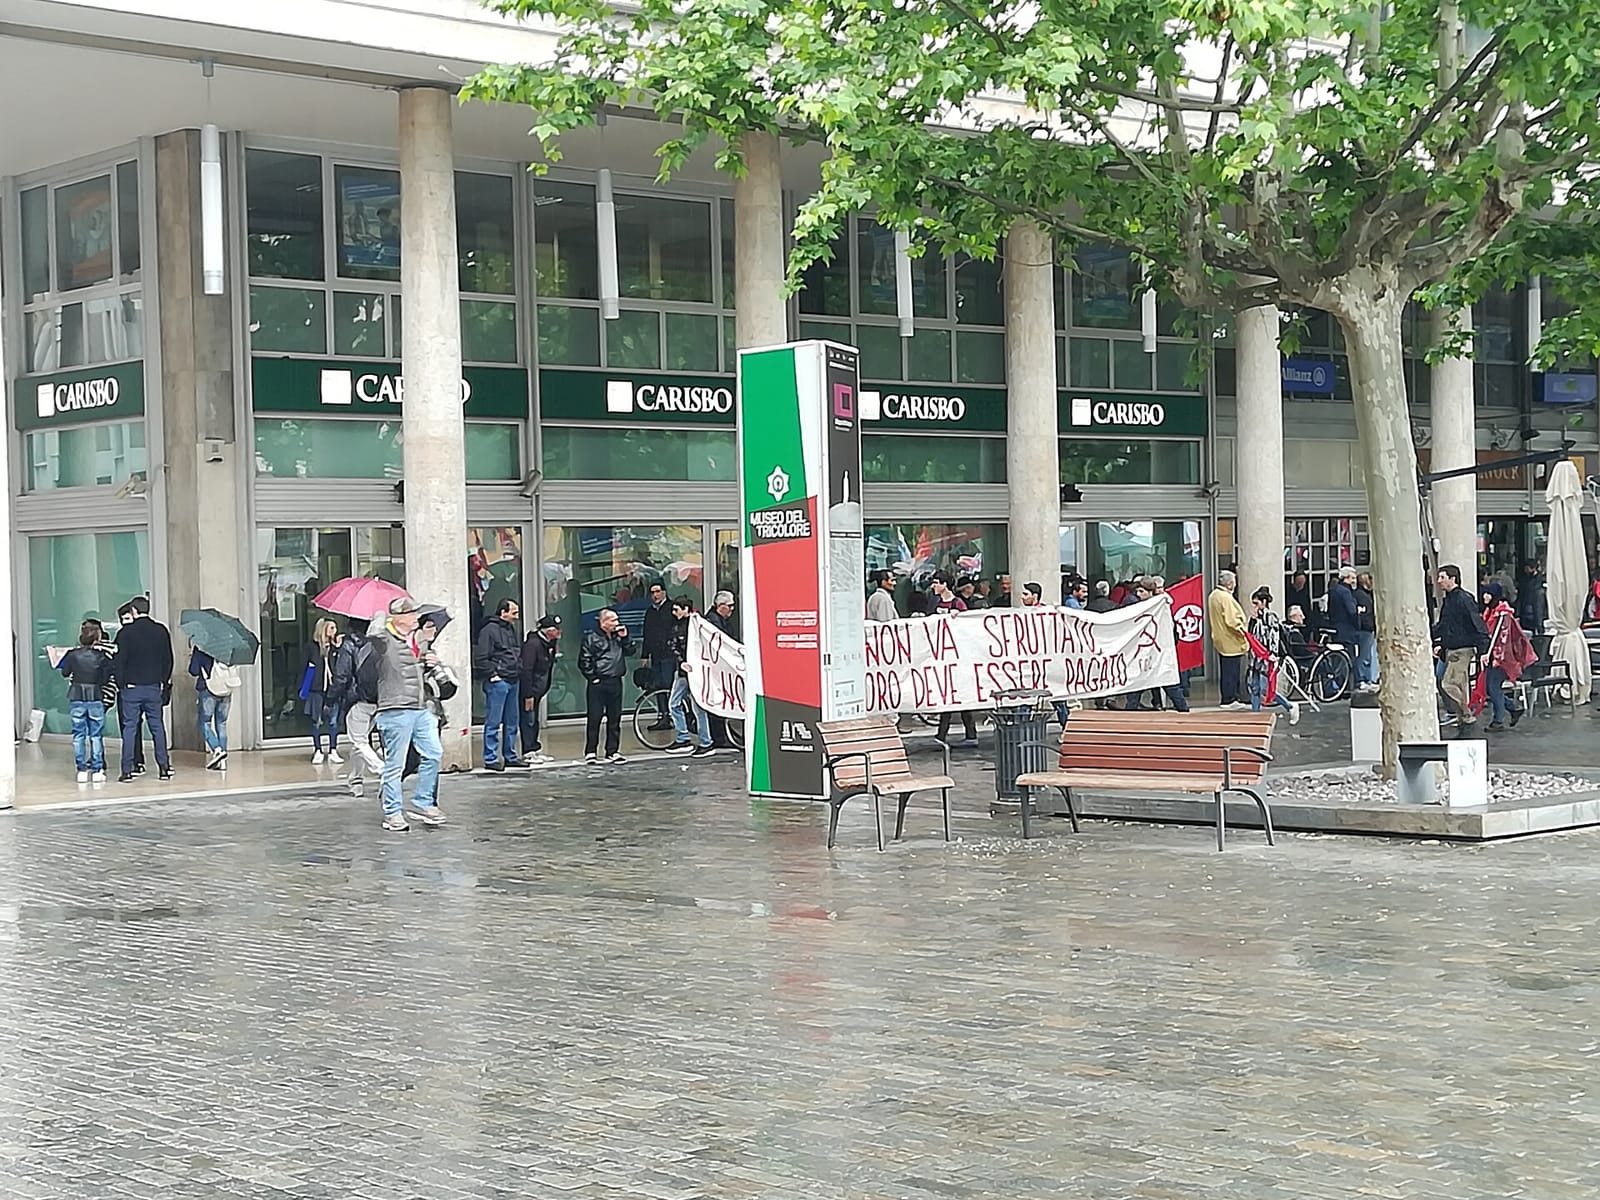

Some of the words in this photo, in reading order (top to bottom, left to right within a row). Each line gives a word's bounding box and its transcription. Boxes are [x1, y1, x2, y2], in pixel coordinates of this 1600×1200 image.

[55, 377, 119, 412] CARISBO
[636, 384, 733, 413] CARISBO
[882, 394, 965, 421] CARISBO
[1093, 402, 1164, 426] CARISBO
[750, 510, 784, 526] MUSEO
[785, 509, 808, 524] DEL
[755, 522, 811, 538] TRICOLORE
[699, 624, 722, 665] LO
[864, 622, 912, 667] NON
[922, 617, 960, 661] VA
[701, 665, 714, 707] IL
[910, 663, 962, 709] DEVE
[973, 659, 1052, 702] ESSERE
[1065, 652, 1128, 695] PAGATO
